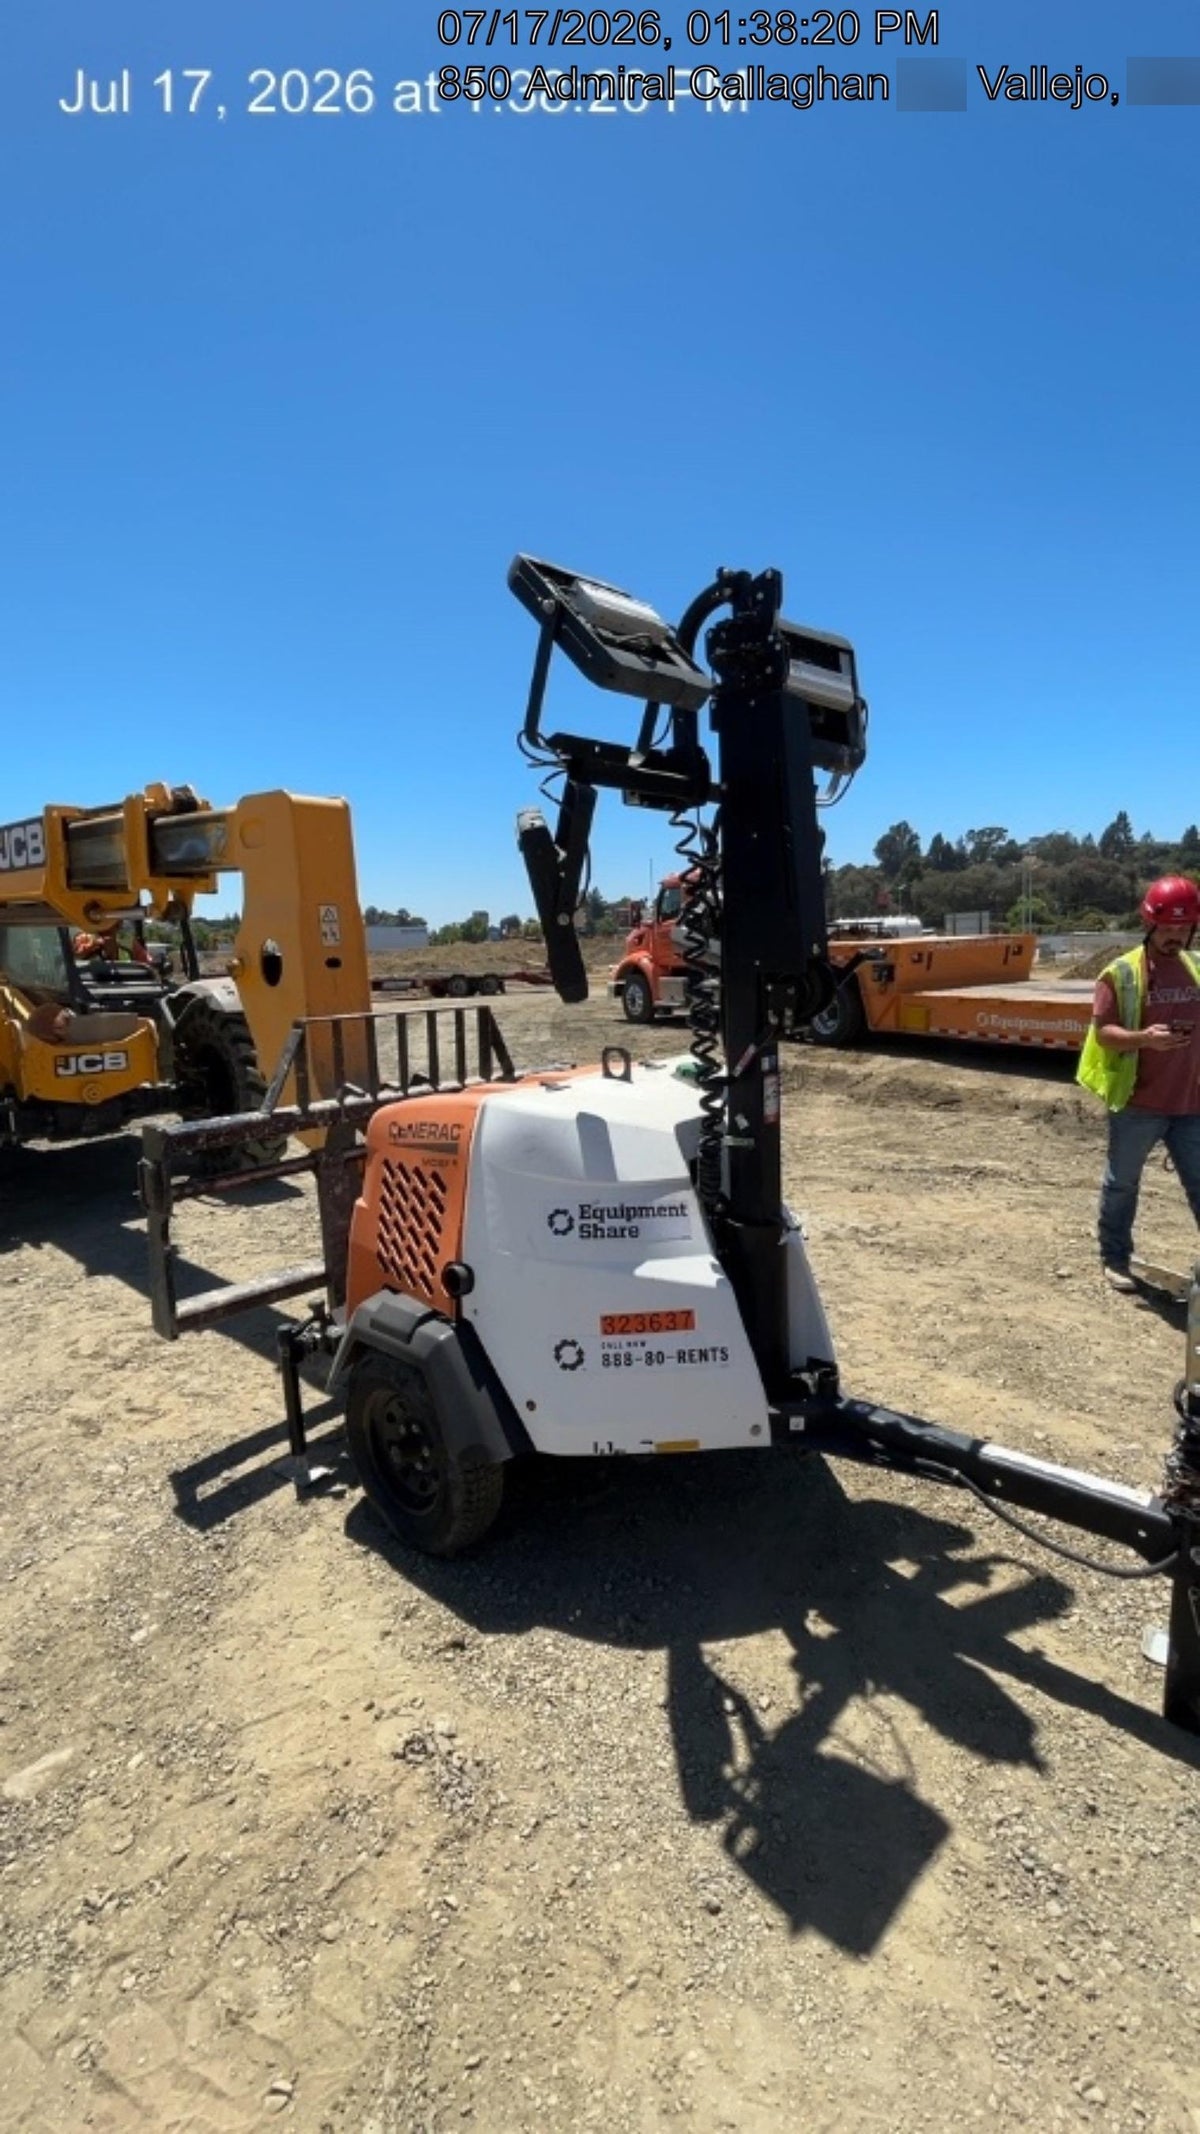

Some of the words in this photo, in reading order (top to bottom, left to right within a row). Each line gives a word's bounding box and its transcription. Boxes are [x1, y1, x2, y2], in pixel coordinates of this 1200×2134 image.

[56, 1051, 127, 1075] JCB
[388, 1121, 462, 1141] GENERAC
[578, 1203, 688, 1222] Equipment
[578, 1223, 640, 1239] Share
[602, 1311, 693, 1335] 323637
[601, 1347, 729, 1367] 888-80-RENTS
